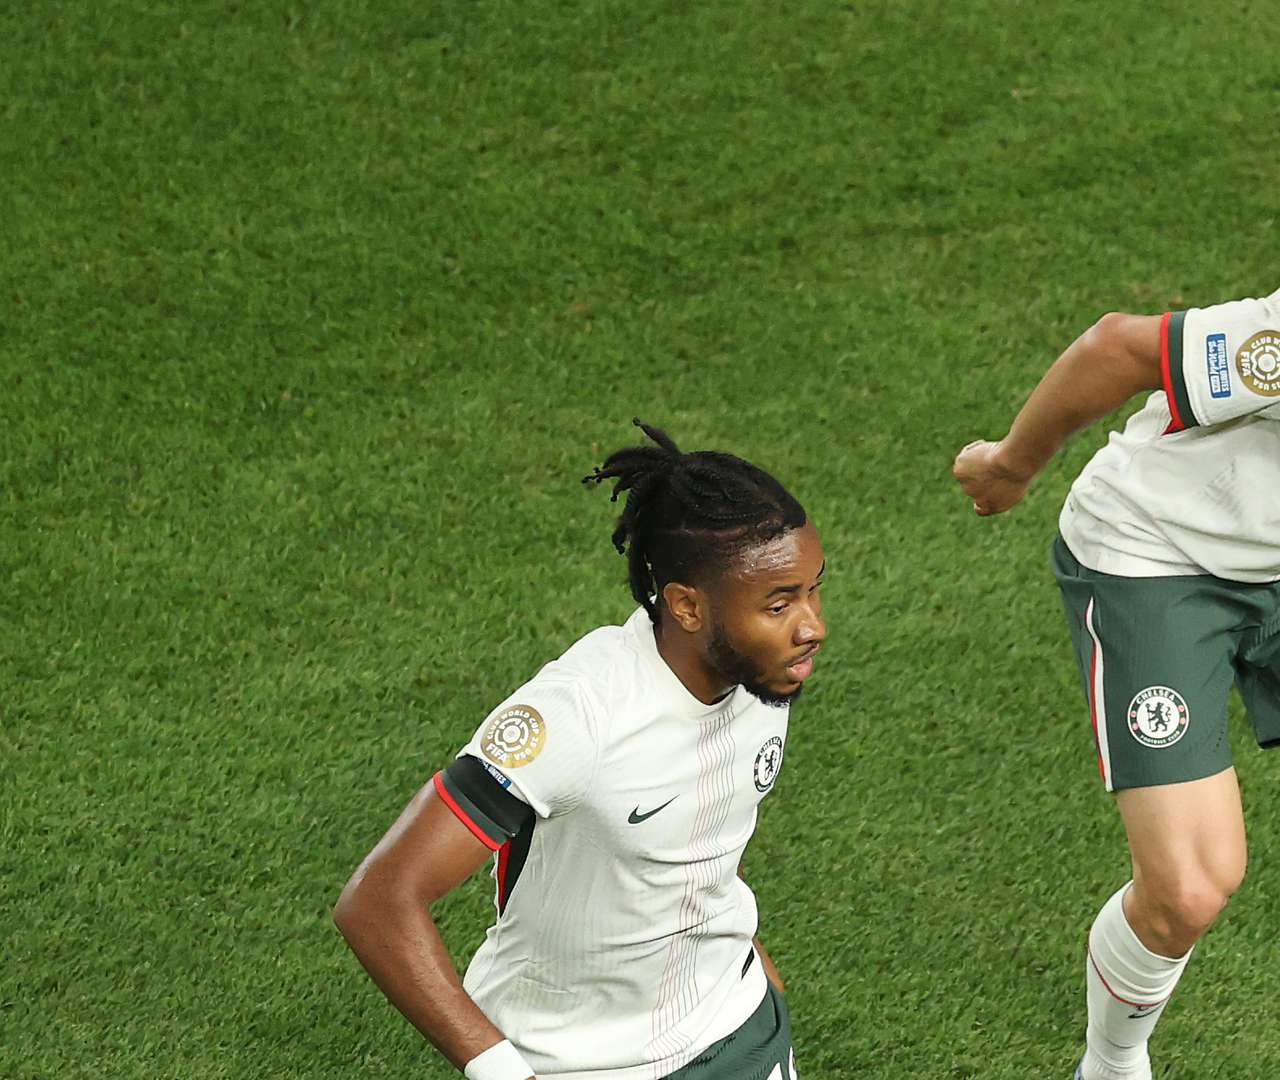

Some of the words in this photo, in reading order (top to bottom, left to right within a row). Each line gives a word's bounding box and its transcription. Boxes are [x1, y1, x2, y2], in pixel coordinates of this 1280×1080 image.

[1251, 336, 1272, 349] CLUB
[1240, 351, 1252, 377] FIFA
[1253, 378, 1270, 391] USA
[1136, 689, 1175, 704] CHELSEA
[485, 742, 508, 763] FIFA
